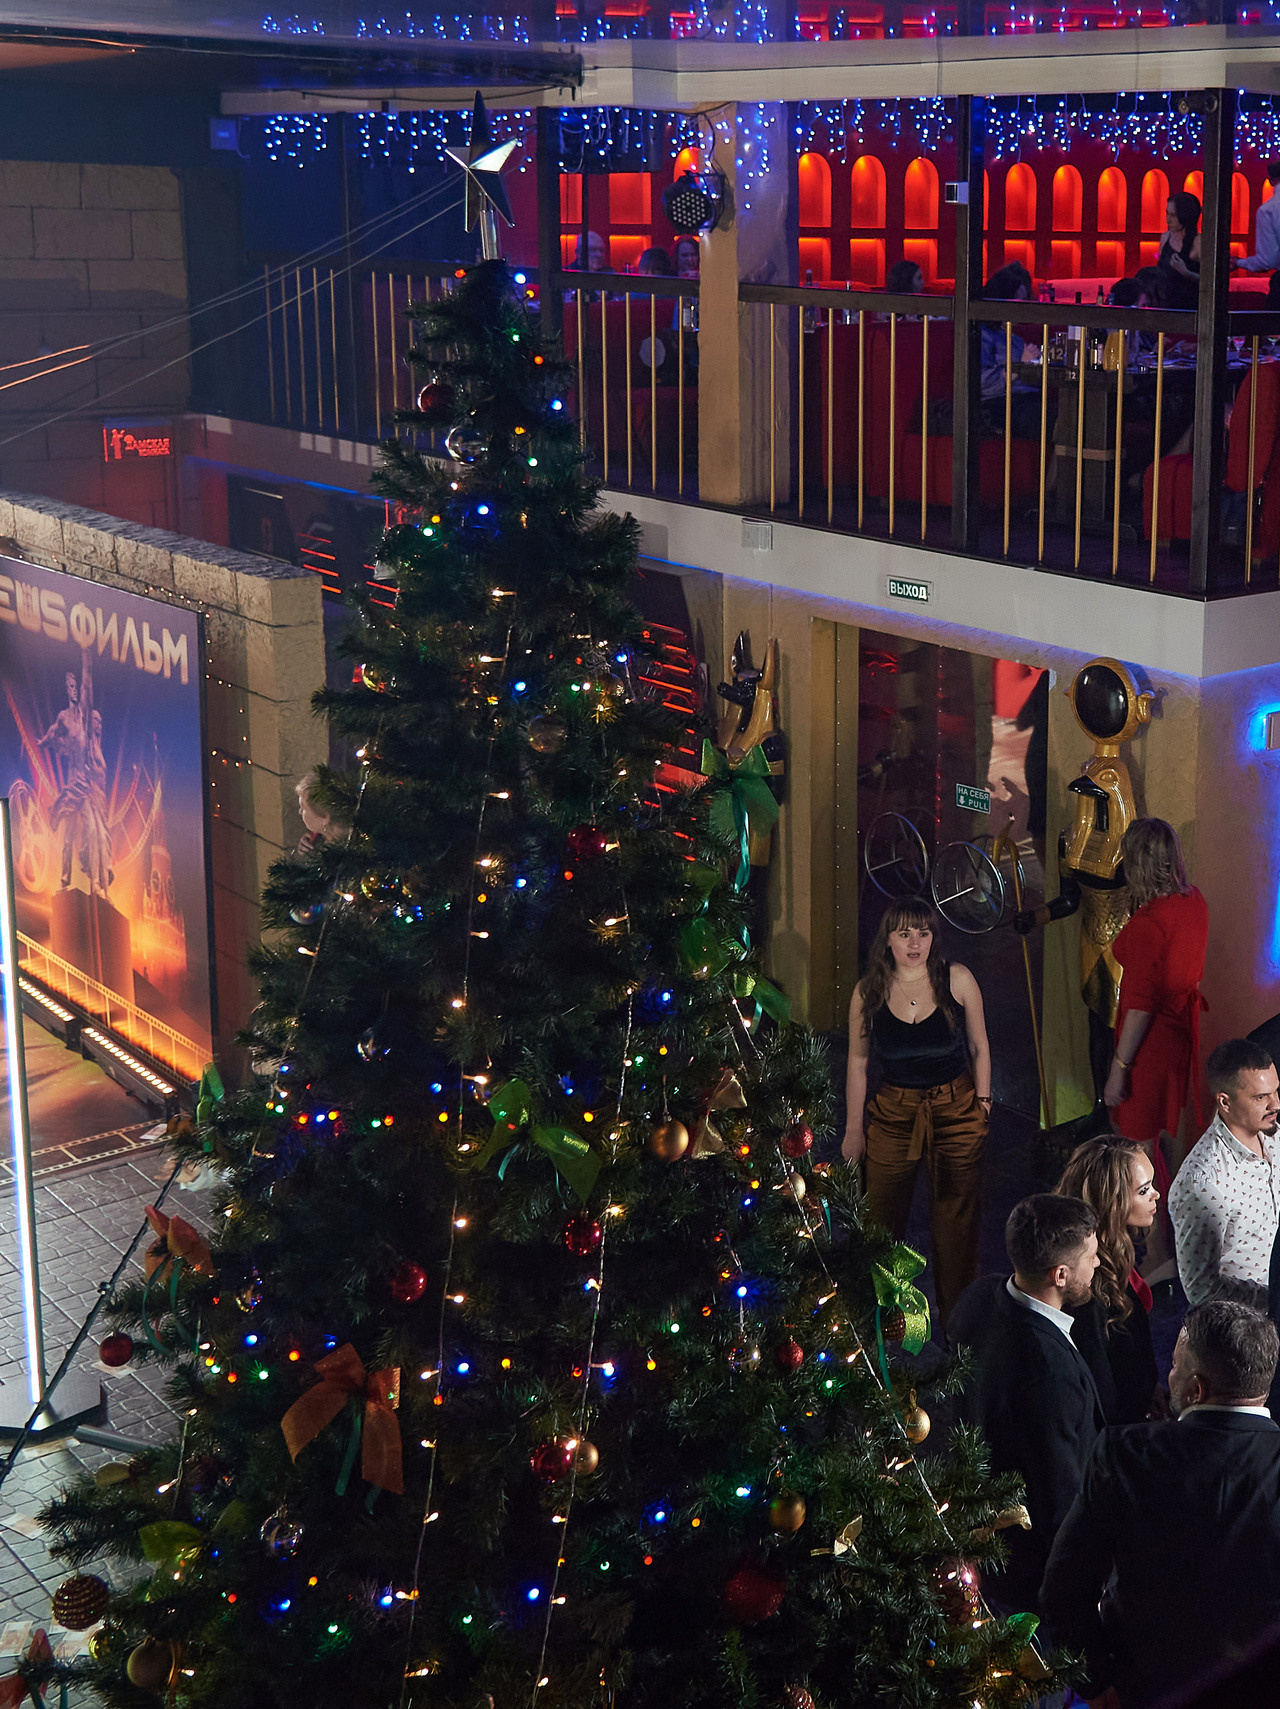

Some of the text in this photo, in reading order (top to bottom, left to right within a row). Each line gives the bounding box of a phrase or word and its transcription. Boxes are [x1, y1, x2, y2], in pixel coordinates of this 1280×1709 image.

[1049, 347, 1064, 360] 12
[890, 581, 927, 600] ВЫХОД
[958, 787, 989, 801] НА СЕБЯ
[968, 799, 988, 811] PULL
